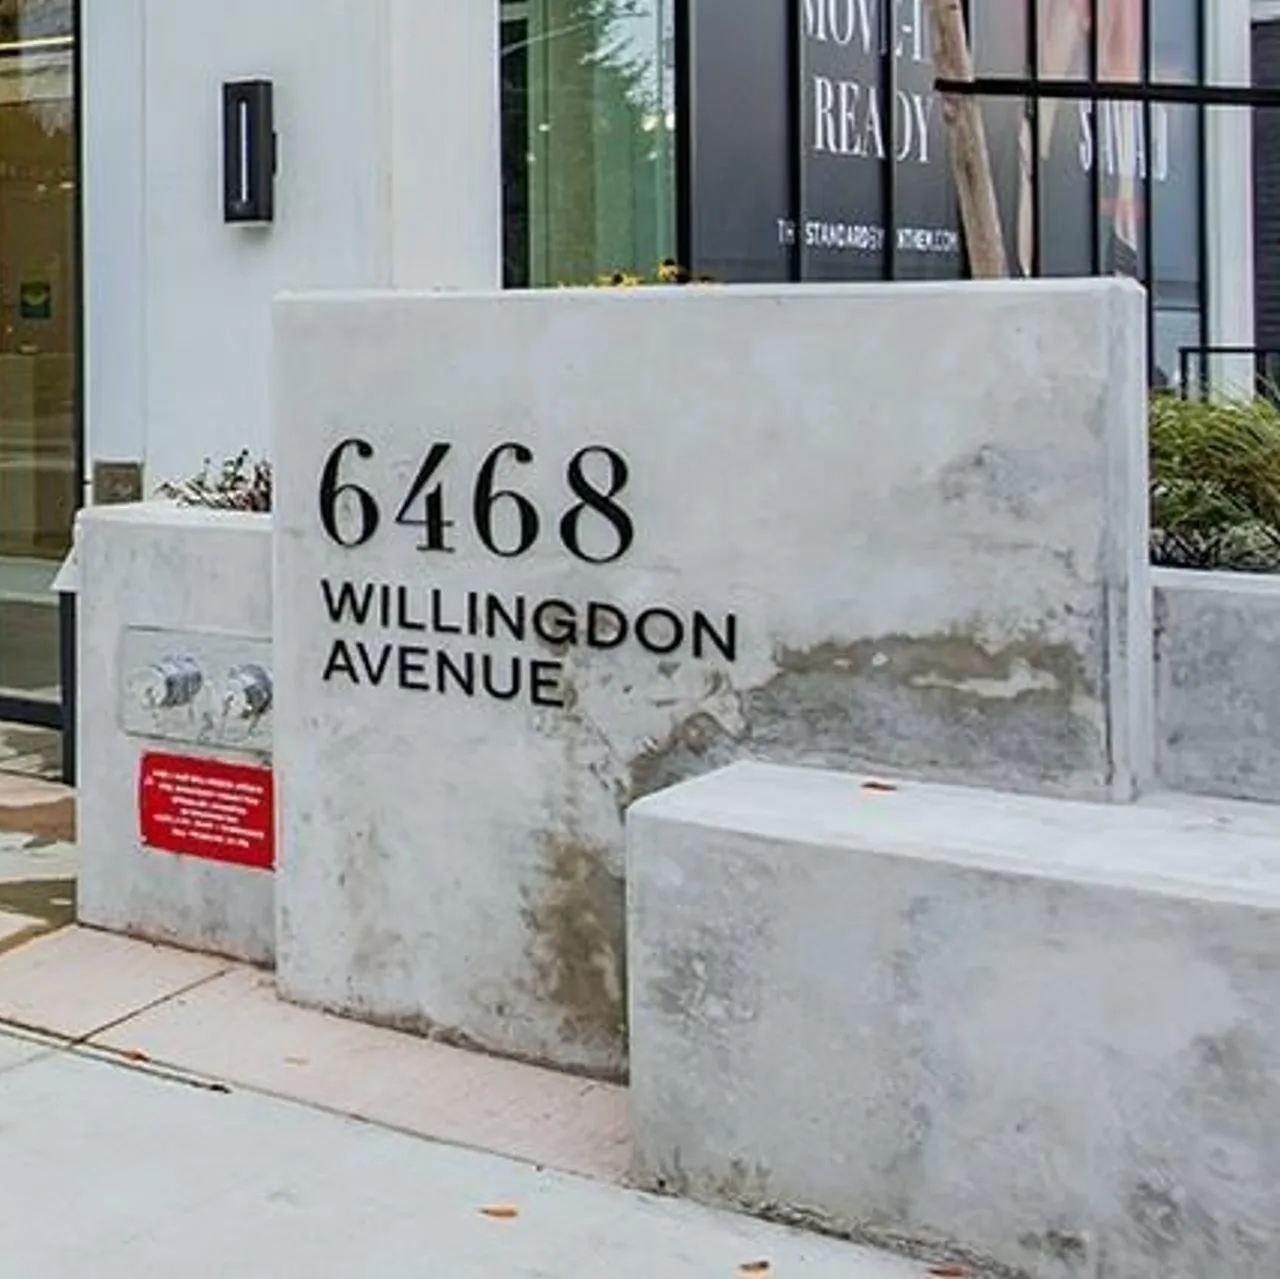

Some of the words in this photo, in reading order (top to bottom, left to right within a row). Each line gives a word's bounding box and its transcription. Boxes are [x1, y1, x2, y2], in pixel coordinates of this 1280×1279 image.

[814, 76, 934, 163] READY
[320, 438, 635, 563] 6468
[321, 578, 737, 662] WILLINGDON
[322, 639, 564, 707] AVENUE
